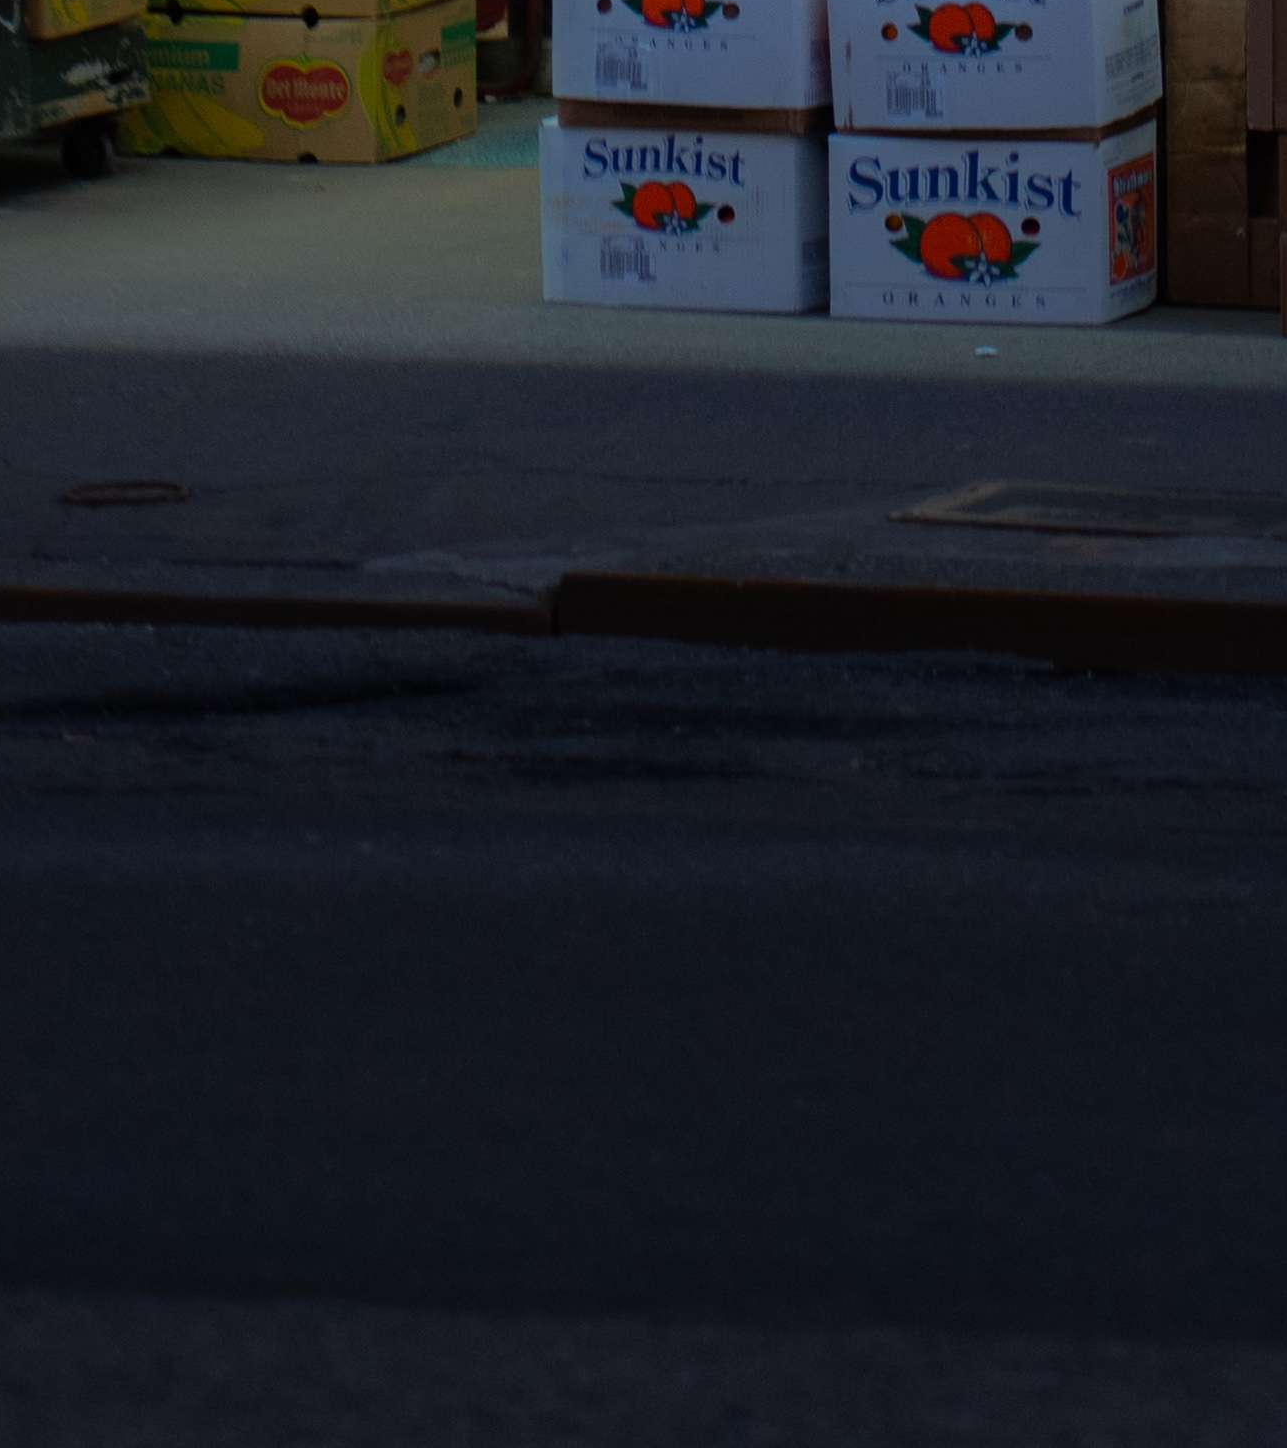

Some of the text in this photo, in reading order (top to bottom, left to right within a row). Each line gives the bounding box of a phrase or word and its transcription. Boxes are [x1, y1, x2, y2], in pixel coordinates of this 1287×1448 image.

[583, 134, 745, 187] Sunkist
[848, 149, 1083, 216] Sunkist
[881, 291, 1047, 310] ORANGES
